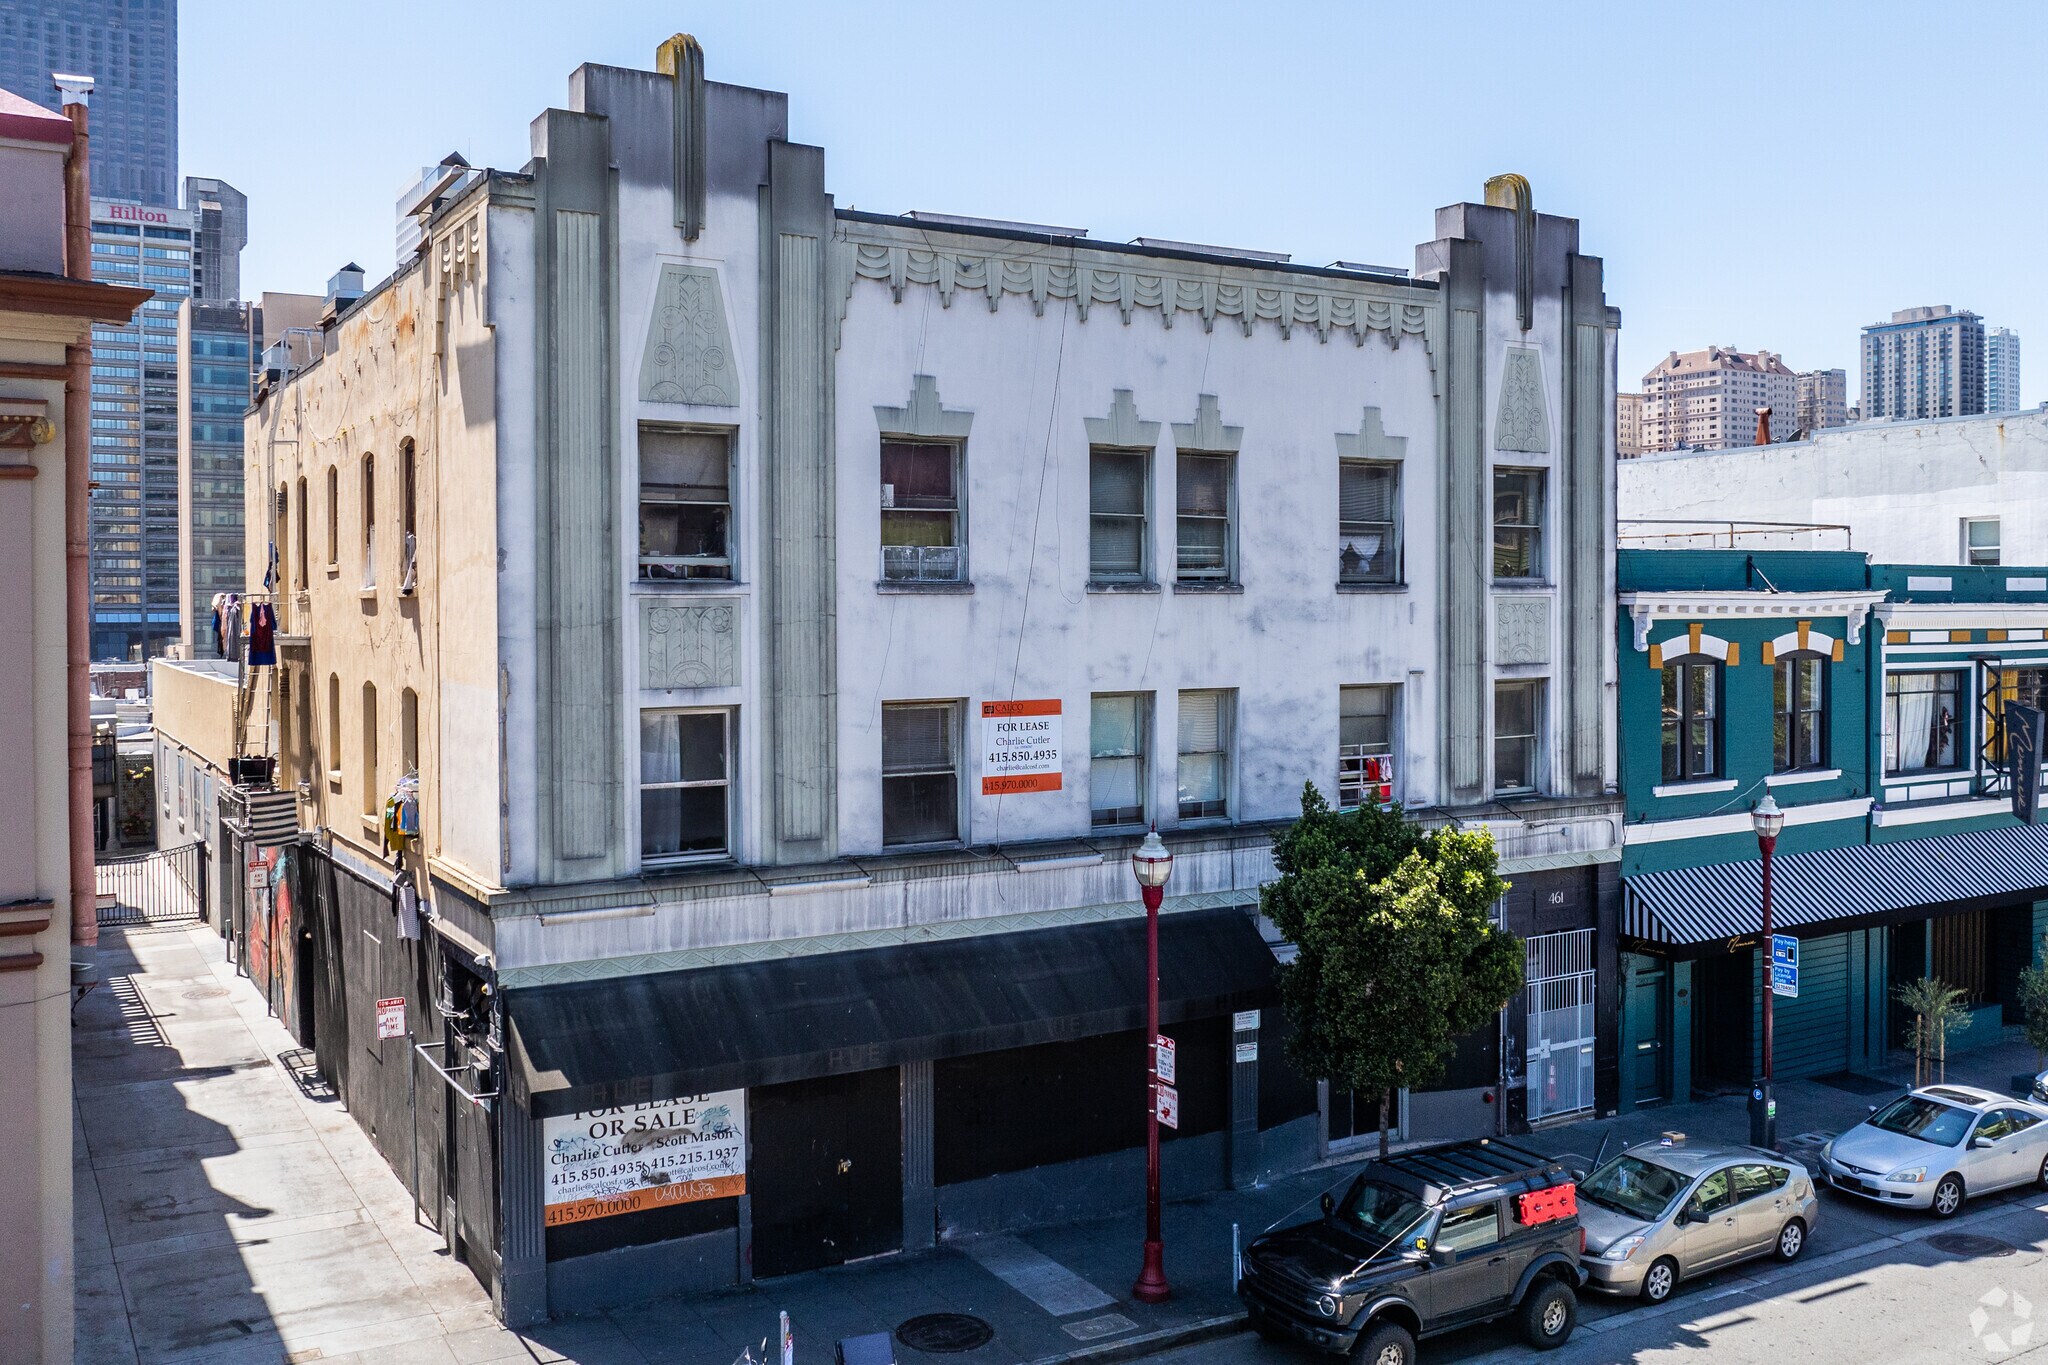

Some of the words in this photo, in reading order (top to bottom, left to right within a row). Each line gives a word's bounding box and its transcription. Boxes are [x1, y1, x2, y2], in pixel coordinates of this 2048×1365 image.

[110, 205, 168, 223] Hilton
[997, 722, 1017, 732] FOR
[1020, 721, 1050, 731] LEASE
[996, 737, 1024, 746] Charlie
[1026, 735, 1051, 745] Cutler
[989, 749, 1057, 763] 415.850.4935
[996, 763, 1049, 772] charlie@calcosf.com
[984, 779, 1037, 791] 415.970.0000
[1548, 890, 1564, 905] 461
[1774, 937, 1784, 946] Pay
[1784, 939, 1797, 947] here
[1774, 966, 1783, 974] Pay
[589, 1121, 627, 1139] OR
[634, 1108, 697, 1132] SALE
[551, 1148, 600, 1165] Charlie
[603, 1142, 644, 1157] Cutler
[656, 1134, 687, 1149] Scott
[691, 1131, 733, 1143] Mason
[551, 1162, 642, 1186] 415.850.4935
[651, 1147, 739, 1169] 415.215.1937
[557, 1176, 636, 1195] charlie@calcosf.com
[548, 1196, 641, 1223] 415.970.0000
